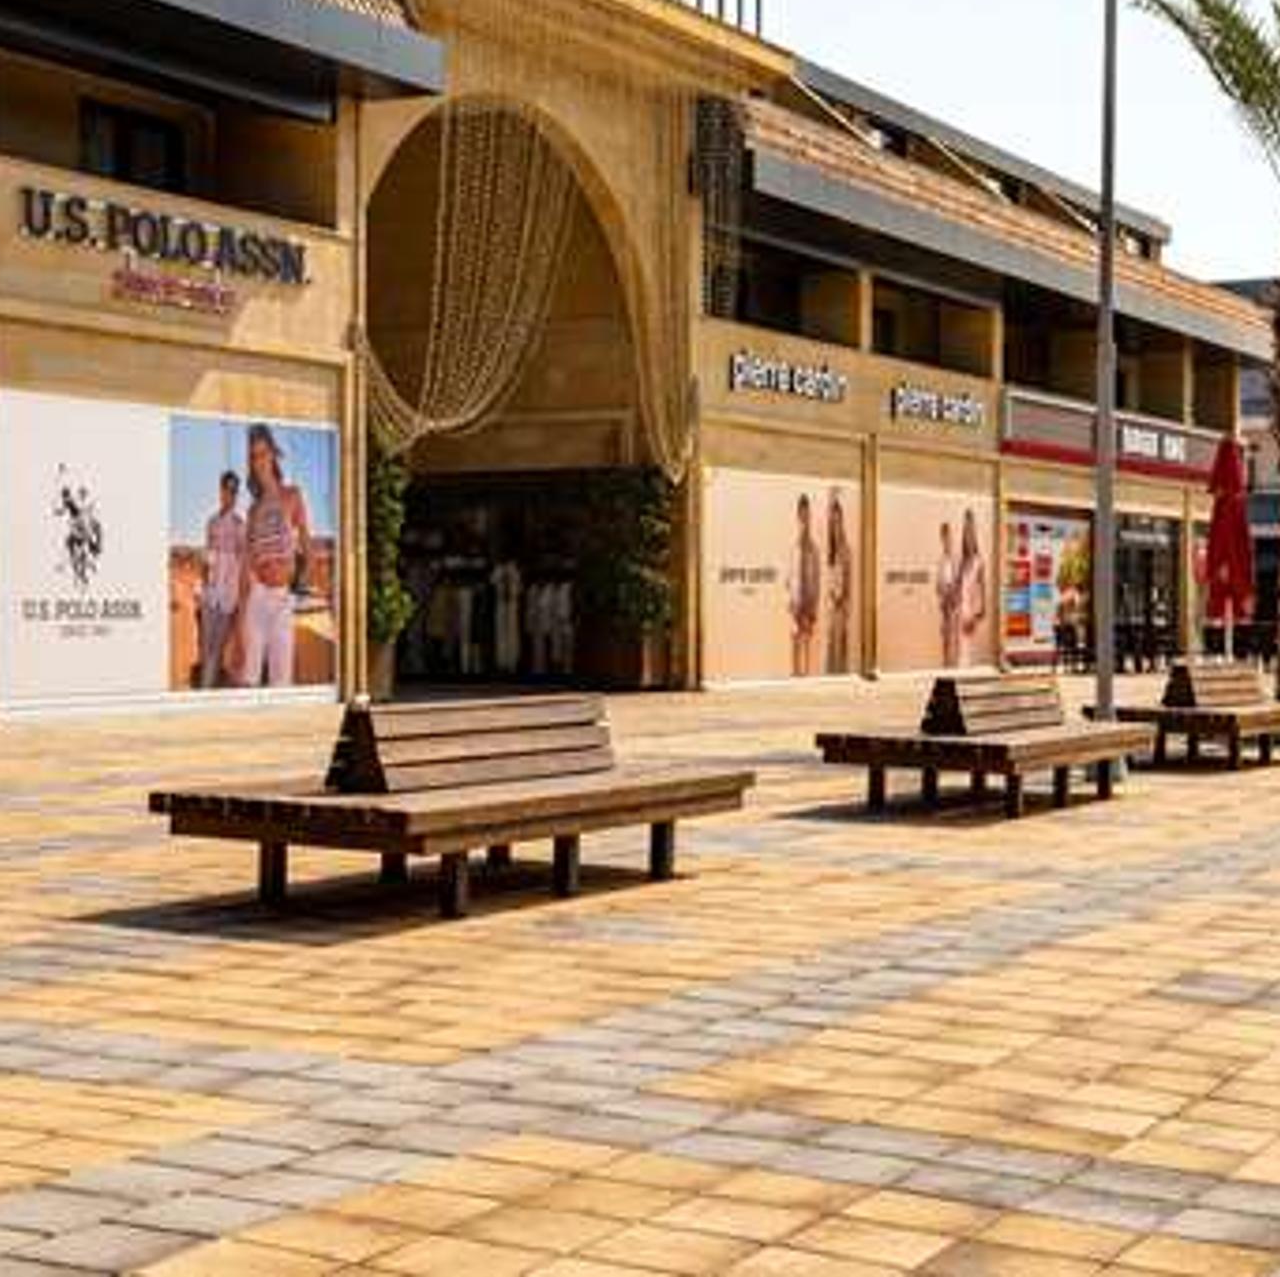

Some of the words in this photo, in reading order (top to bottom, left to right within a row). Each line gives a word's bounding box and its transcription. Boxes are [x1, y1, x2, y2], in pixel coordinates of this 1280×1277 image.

[19, 186, 98, 247] U.S.
[104, 201, 209, 266] POLO
[214, 224, 313, 285] ASSN.
